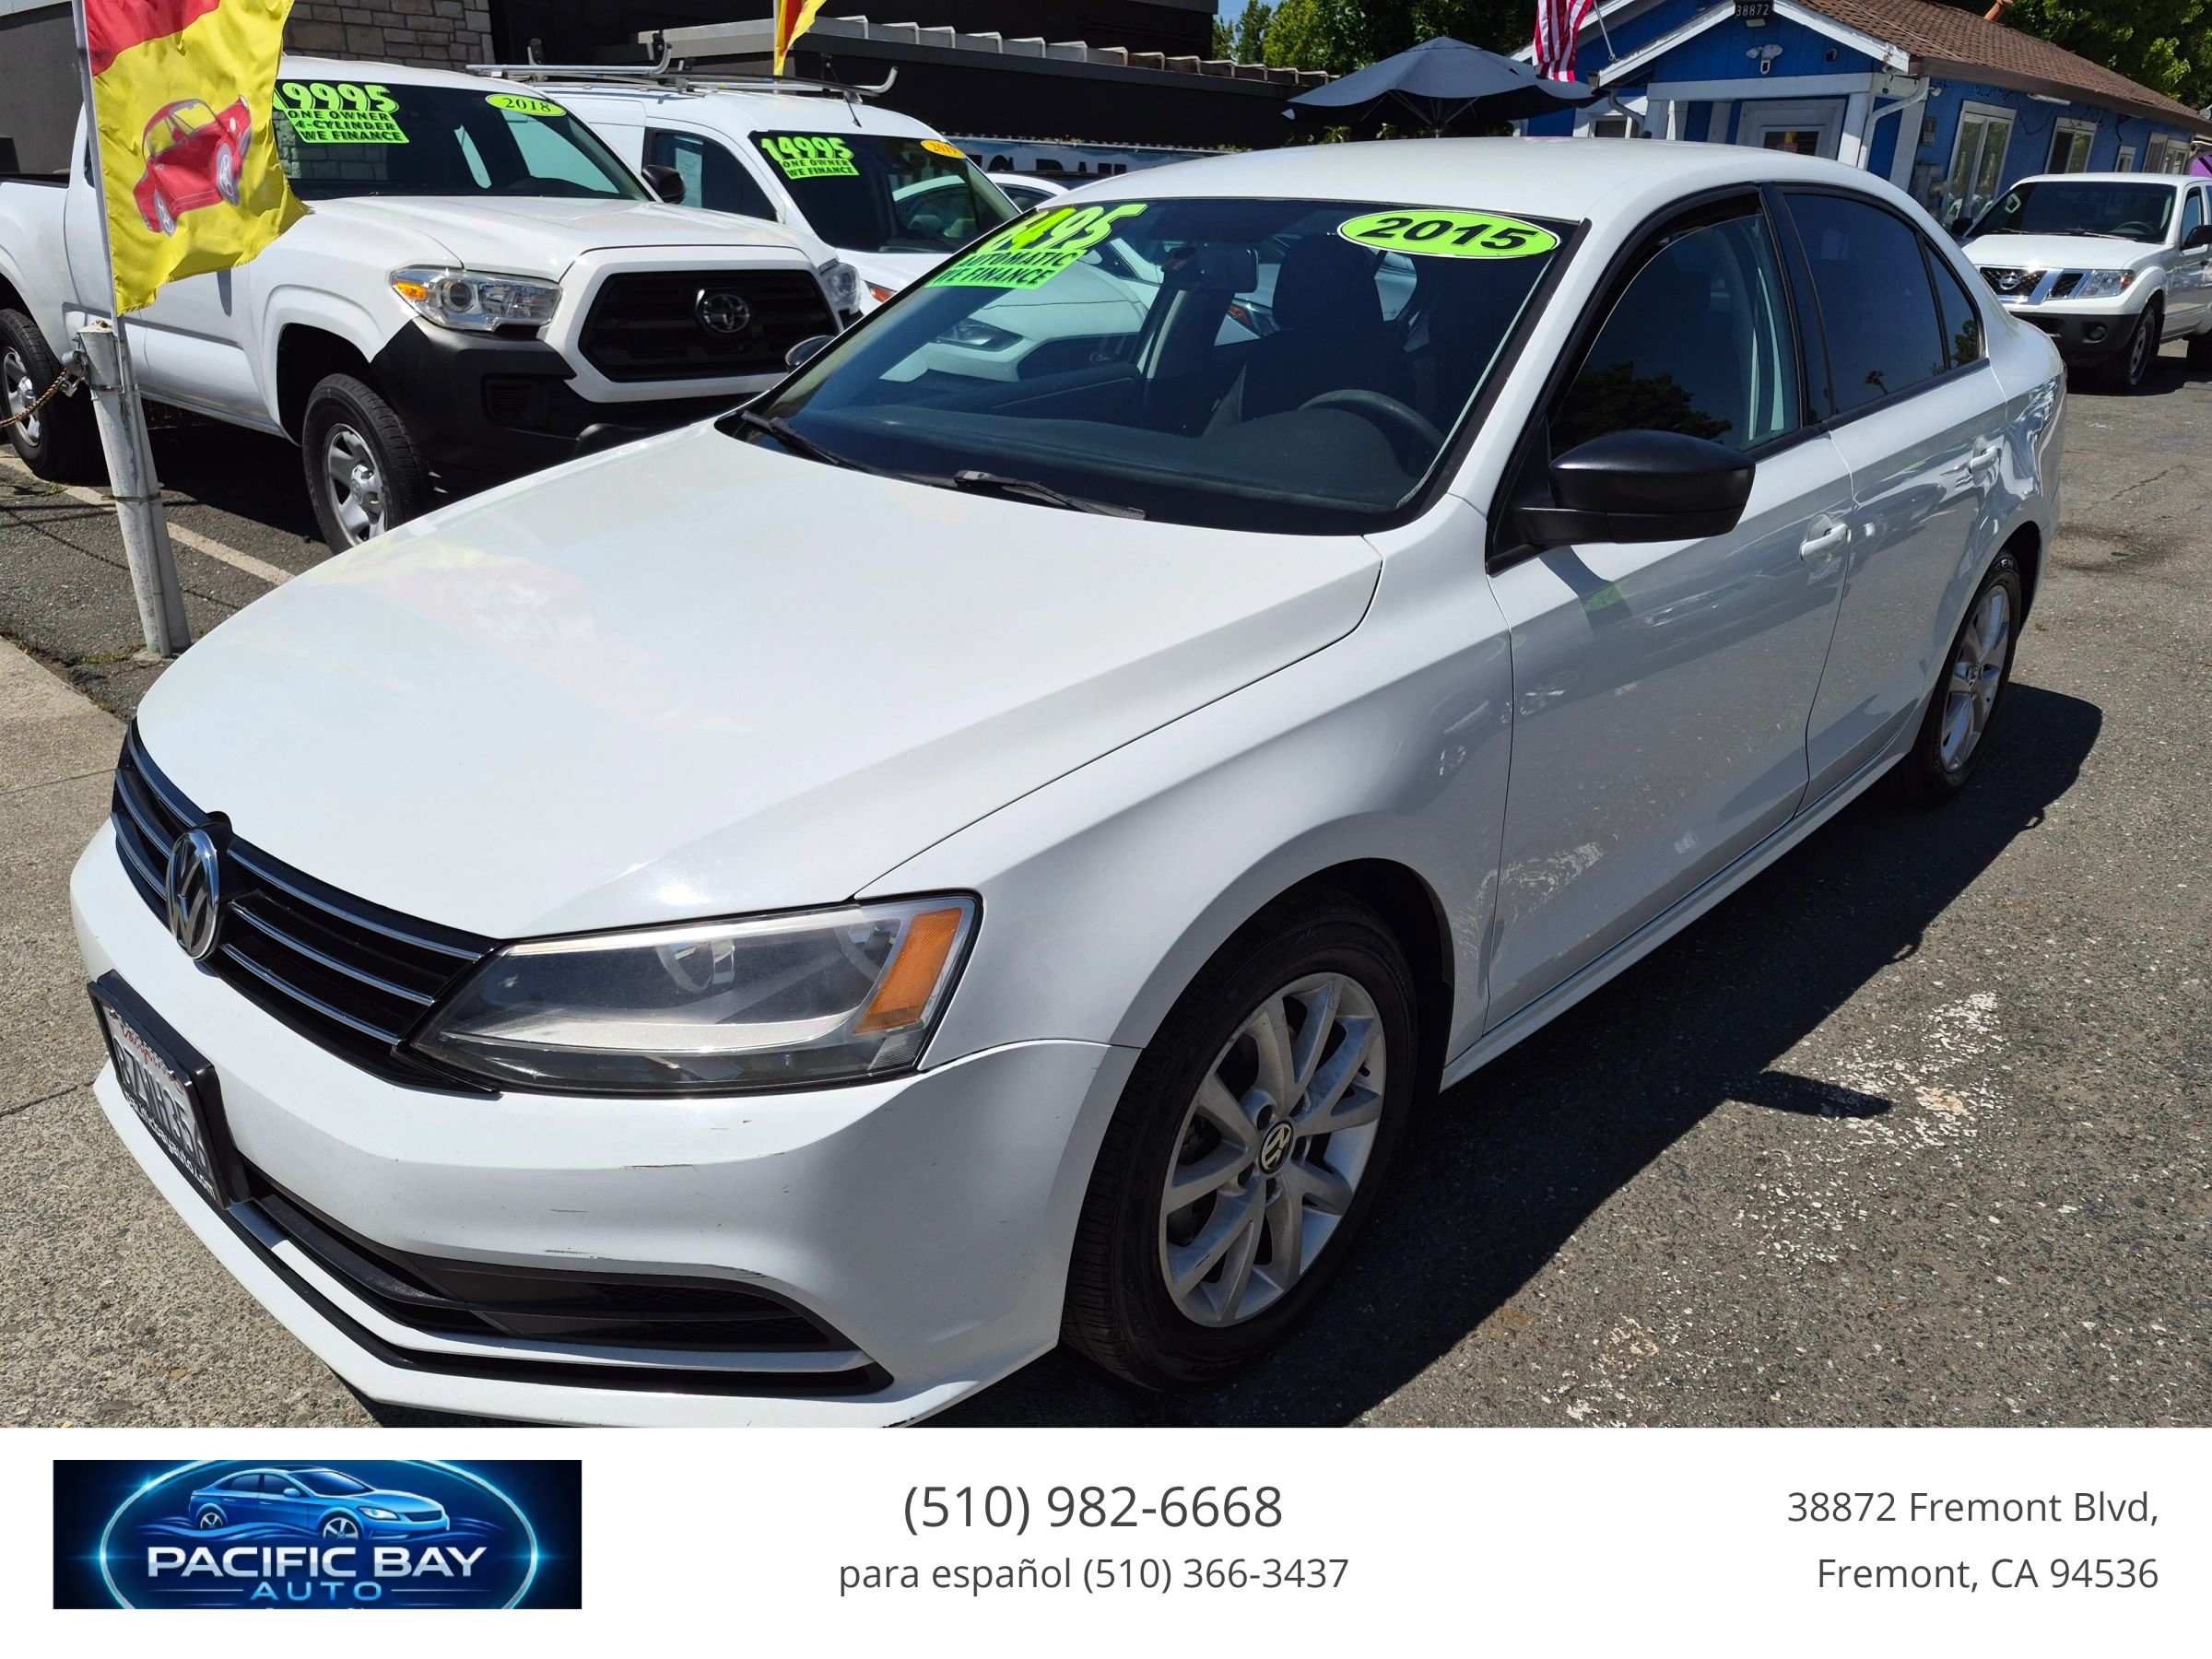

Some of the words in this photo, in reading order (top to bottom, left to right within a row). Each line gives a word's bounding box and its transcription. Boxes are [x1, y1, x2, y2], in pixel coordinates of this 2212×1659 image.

[1735, 4, 1770, 17] 38872
[502, 97, 551, 112] 2018
[288, 110, 324, 119] ONE
[329, 111, 390, 121] OWNER
[295, 121, 395, 130] 4-CYLINDER
[300, 131, 327, 140] WE
[332, 131, 403, 141] FINANCE
[761, 136, 854, 161] 14995
[787, 169, 806, 177] WE
[808, 167, 855, 175] FINANCE
[1357, 217, 1538, 250] 2015
[959, 252, 1079, 267] AUTOMATIC
[934, 268, 961, 284] WE
[959, 267, 1058, 285] FINANCE
